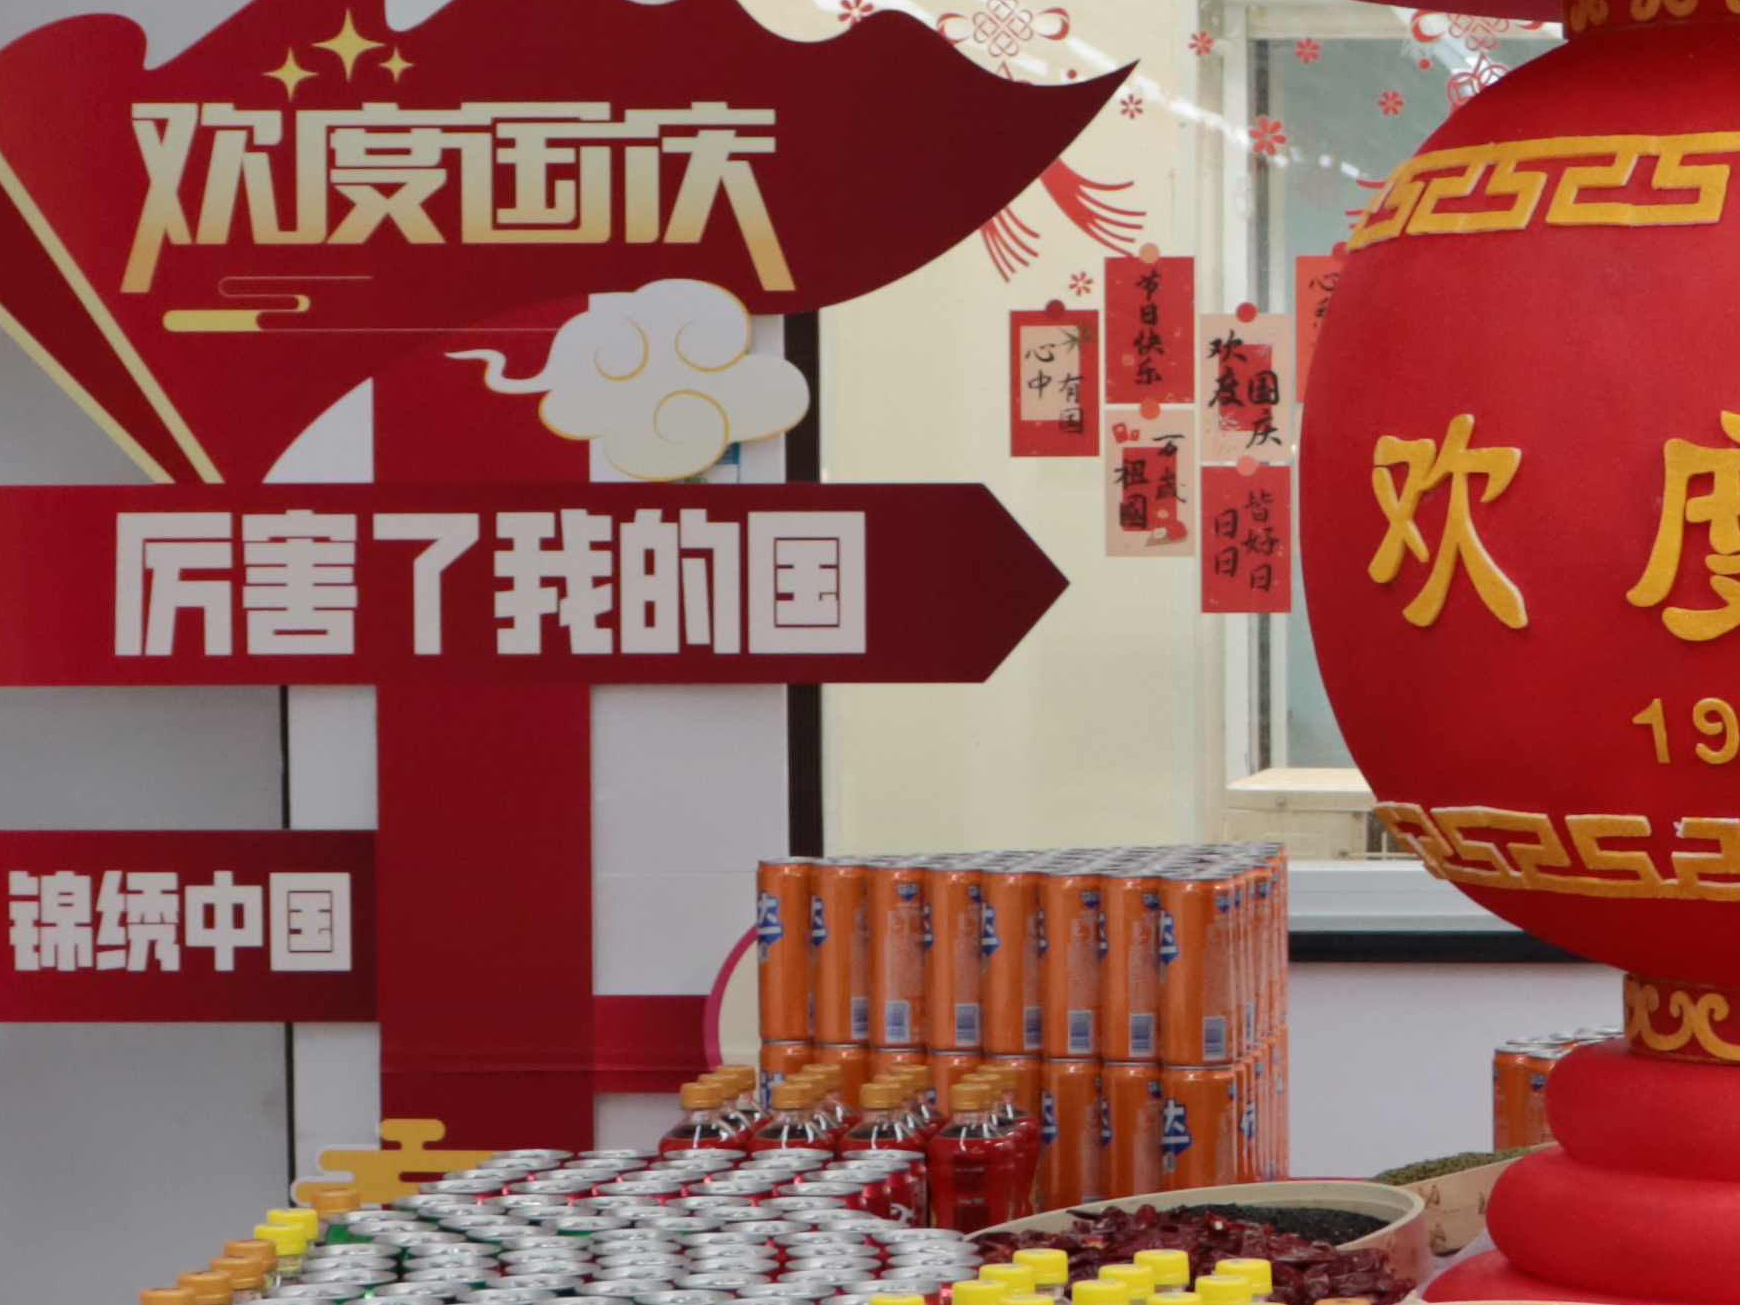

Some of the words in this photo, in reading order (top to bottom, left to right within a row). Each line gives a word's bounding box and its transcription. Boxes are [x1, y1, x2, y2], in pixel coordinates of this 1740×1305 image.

[121, 101, 795, 293] 欢度国庆
[1025, 342, 1056, 399] 心中
[1133, 269, 1165, 386] 节日快乐
[1058, 372, 1085, 434] 有国
[115, 509, 867, 656] 厉害了我的国
[8, 870, 352, 971] 锦绣中国
